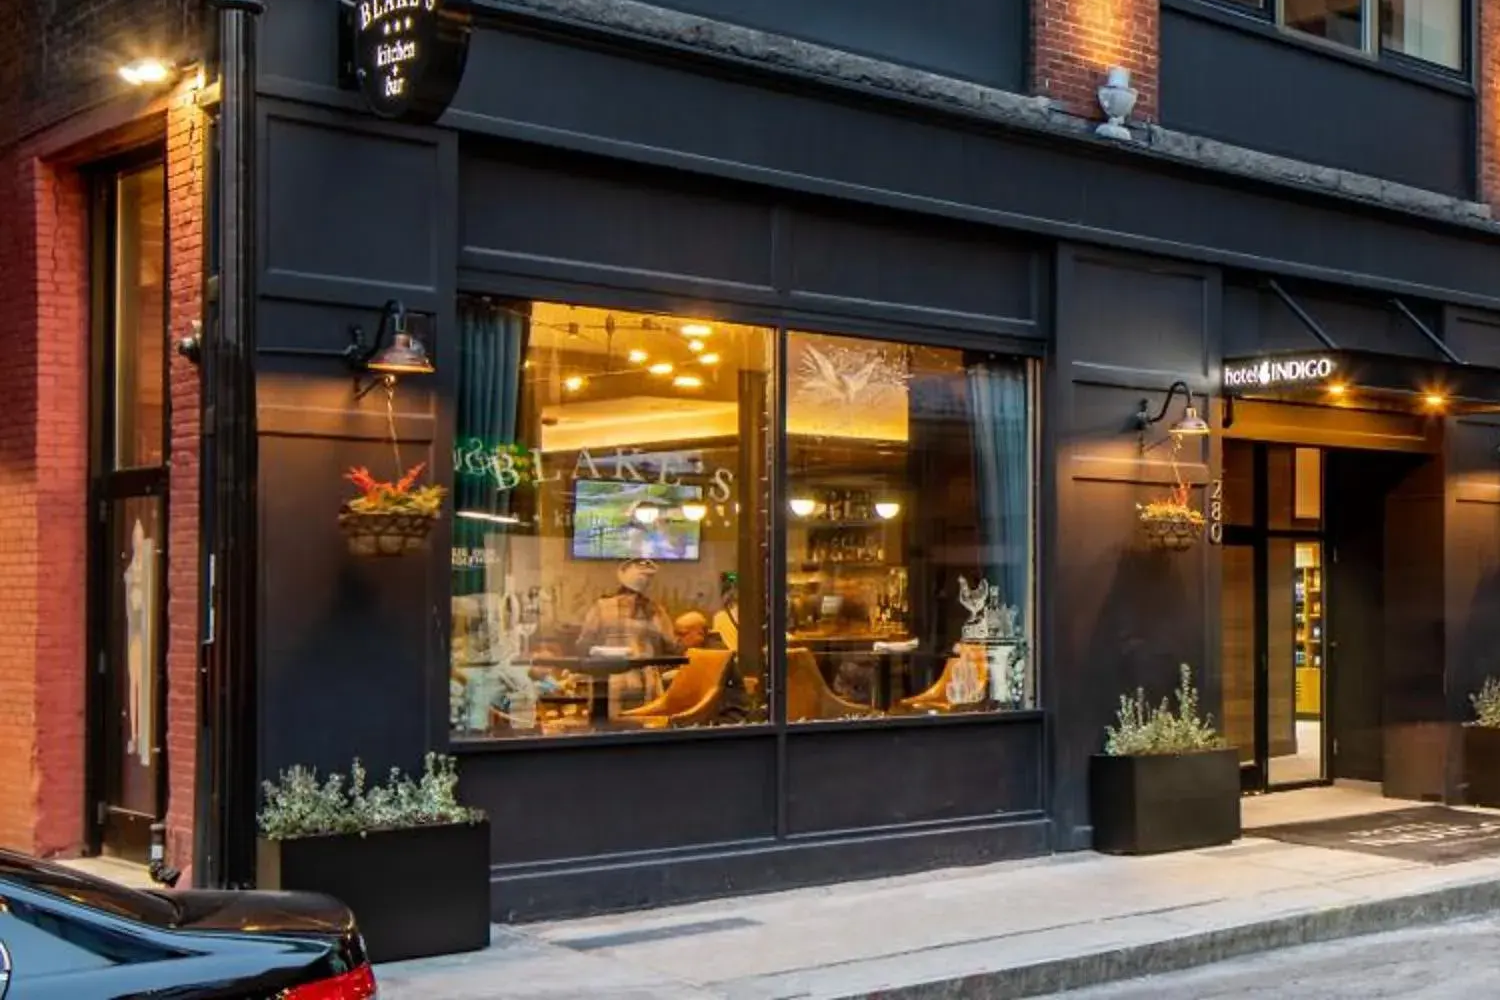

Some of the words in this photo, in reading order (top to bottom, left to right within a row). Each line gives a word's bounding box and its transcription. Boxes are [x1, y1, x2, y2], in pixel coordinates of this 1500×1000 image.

[377, 40, 416, 67] kitchen
[385, 75, 405, 97] bar
[1224, 364, 1259, 385] hotel
[1271, 359, 1332, 381] INDIGO
[492, 446, 734, 503] BLAKE'S
[1210, 479, 1223, 544] 280
